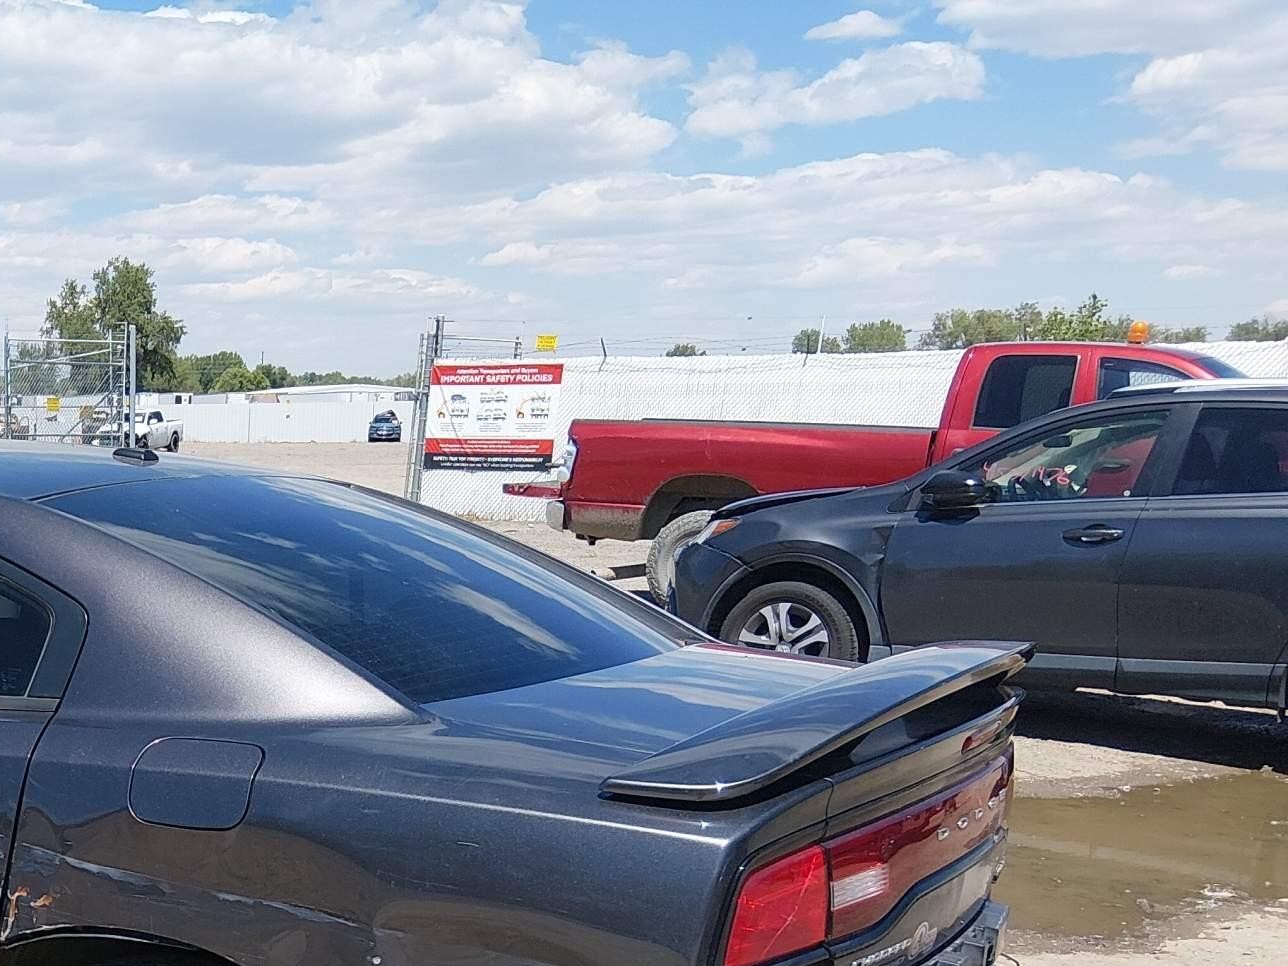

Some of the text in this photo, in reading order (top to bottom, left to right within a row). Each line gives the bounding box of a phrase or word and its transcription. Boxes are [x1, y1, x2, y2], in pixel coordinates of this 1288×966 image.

[440, 374, 553, 384] IMPORTANT SAFETY POLICIES
[937, 788, 1007, 841] DODGE
